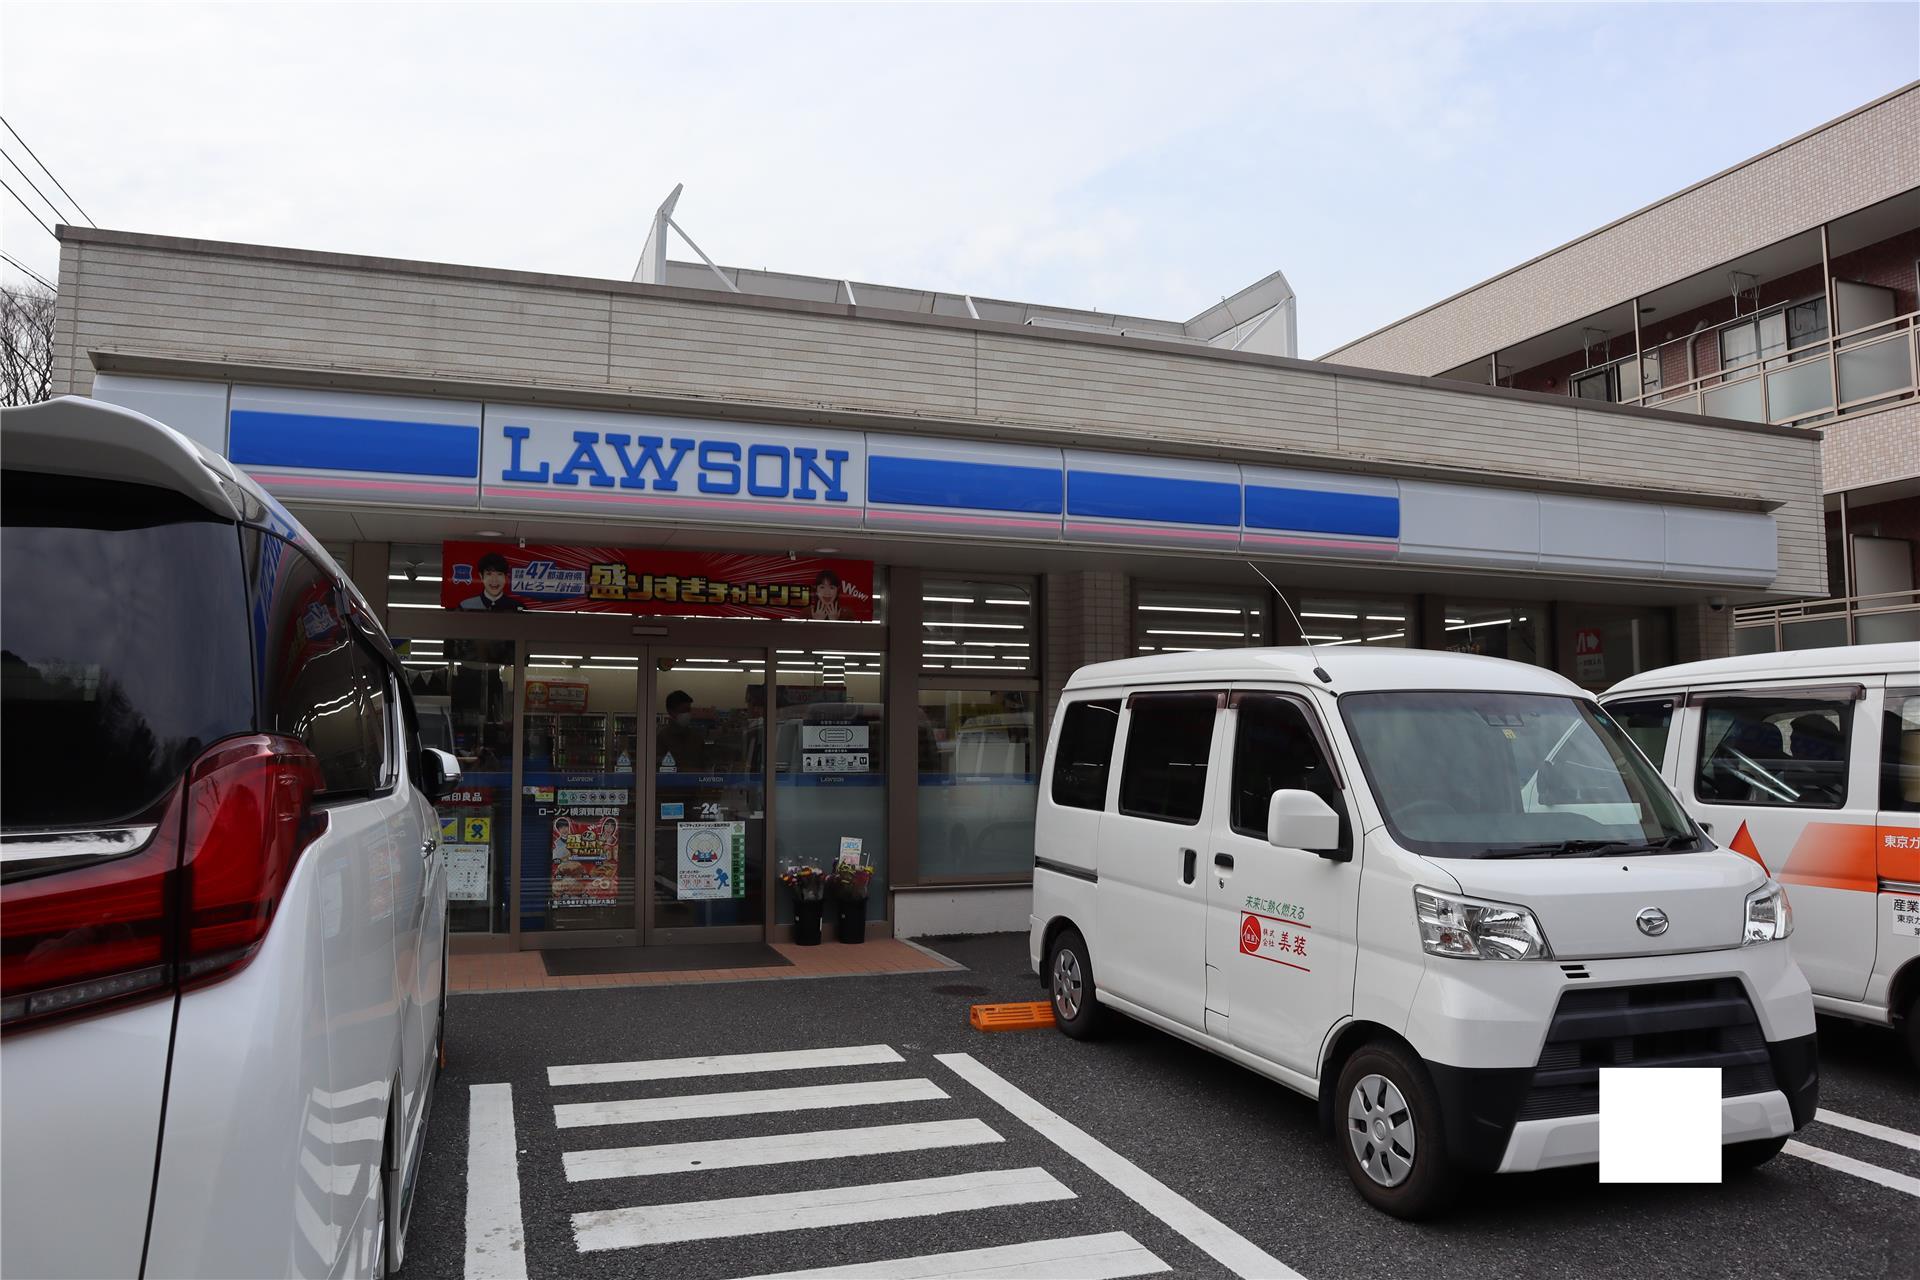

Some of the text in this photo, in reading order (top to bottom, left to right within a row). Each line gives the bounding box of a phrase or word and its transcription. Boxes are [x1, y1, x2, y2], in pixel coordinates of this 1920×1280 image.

[502, 426, 849, 502] LAWSON
[589, 564, 811, 607] 盛りすぎチャレンジ
[701, 802, 719, 814] 24
[1245, 896, 1305, 920] 未来に熱く燃える
[1893, 898, 1920, 914] 産業
[1278, 931, 1307, 957] 美装
